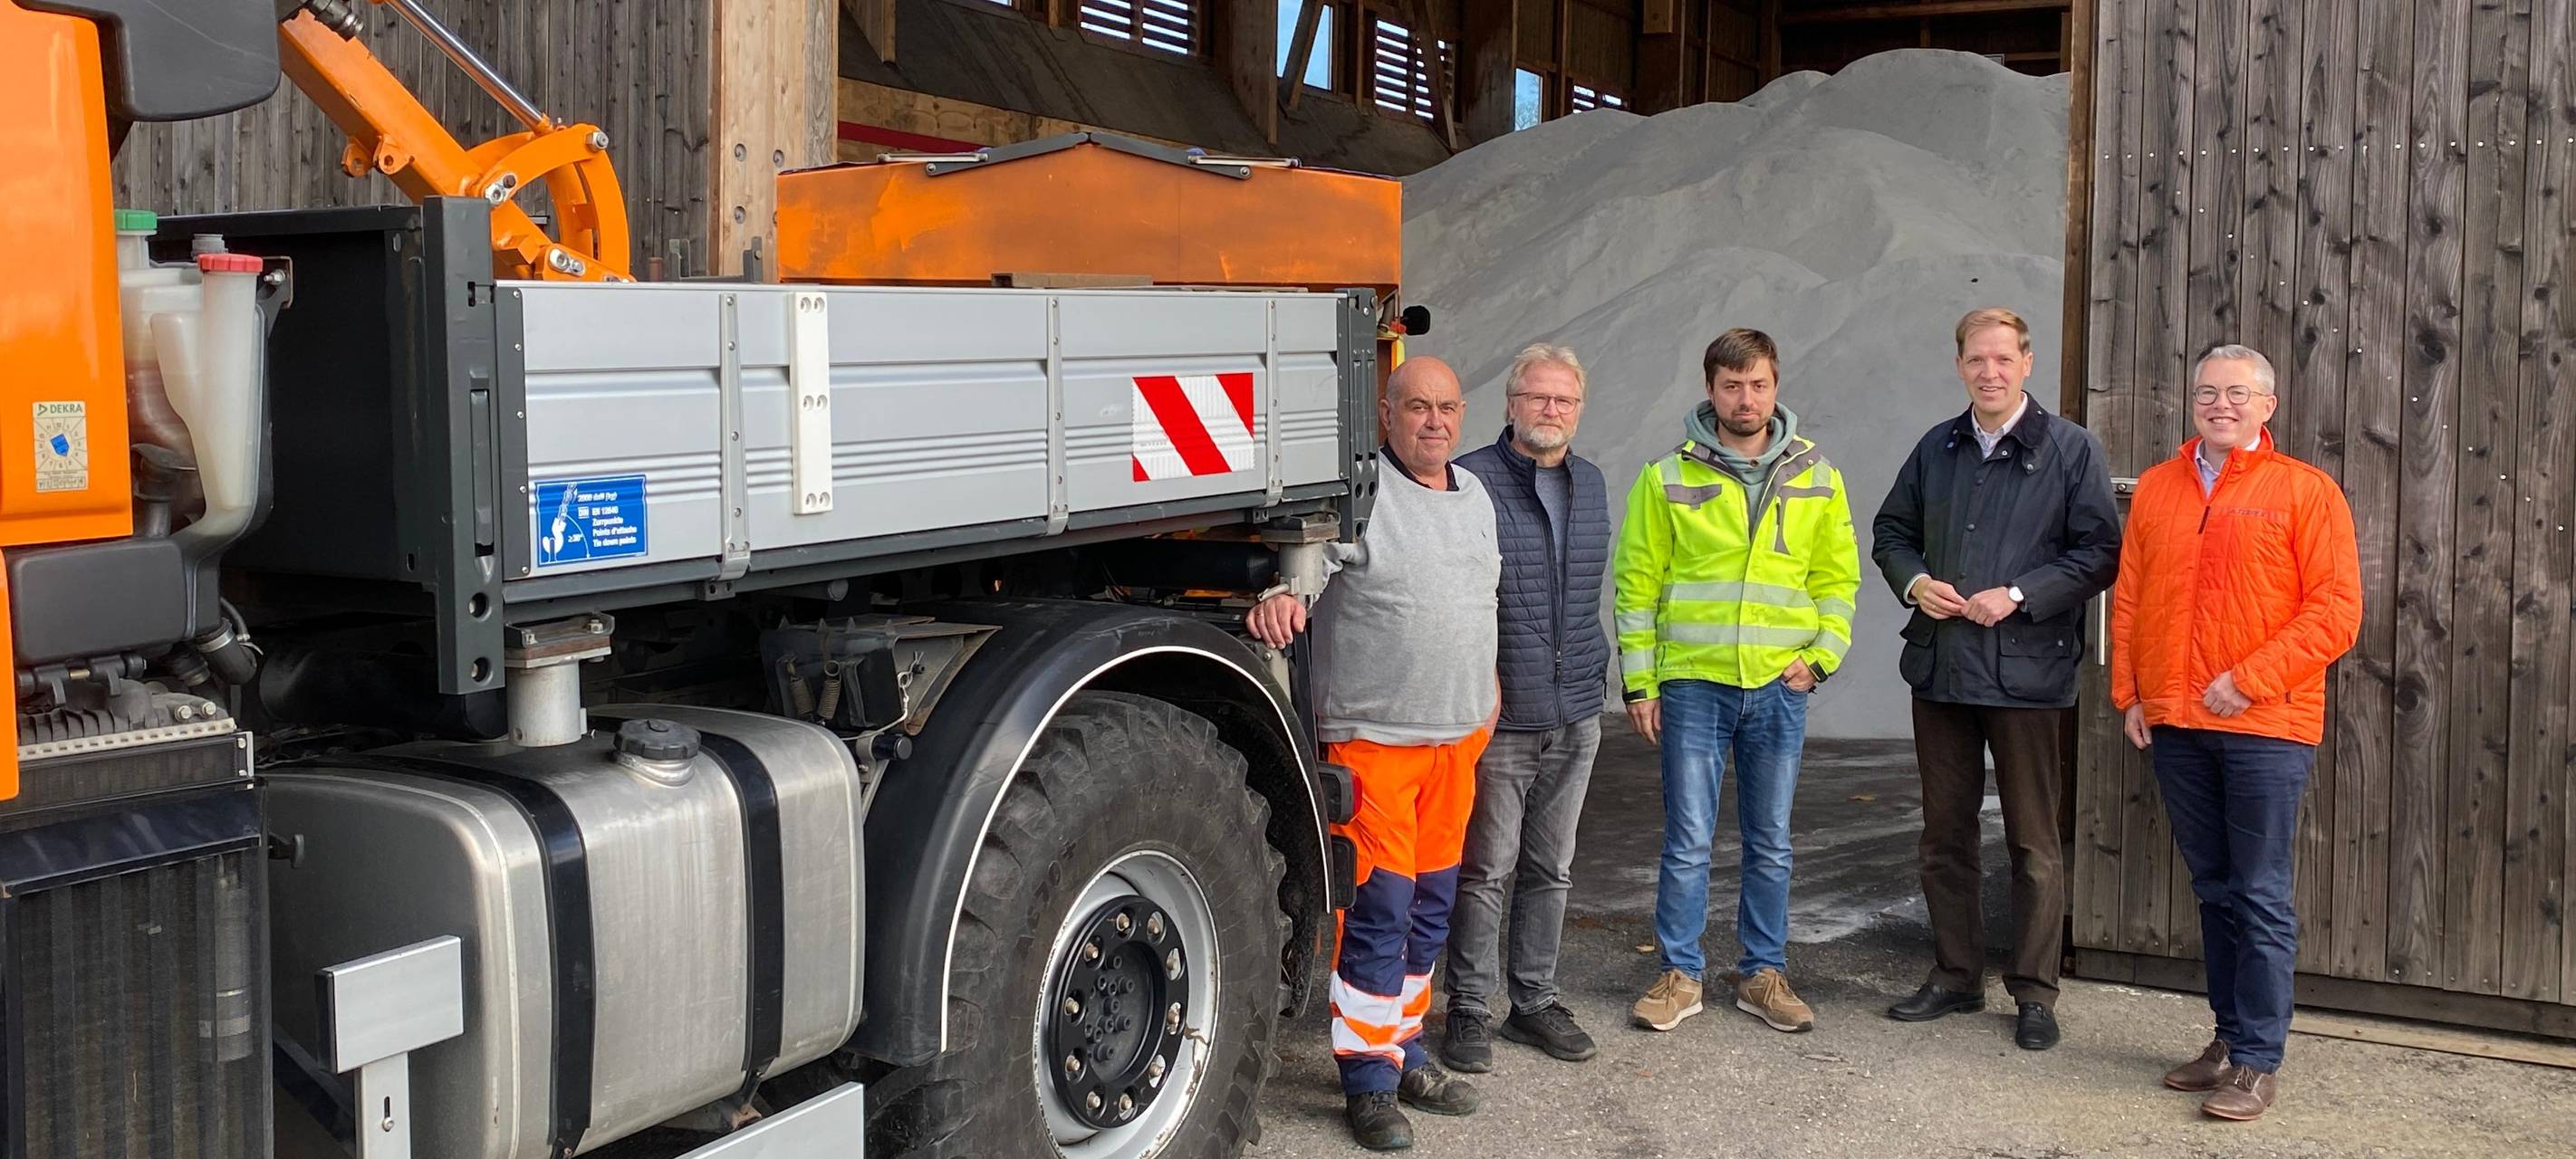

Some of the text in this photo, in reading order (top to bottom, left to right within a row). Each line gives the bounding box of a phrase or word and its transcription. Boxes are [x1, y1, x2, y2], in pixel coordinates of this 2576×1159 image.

[50, 404, 82, 414] DEKRA
[593, 538, 601, 547] Tie
[602, 537, 618, 546] down
